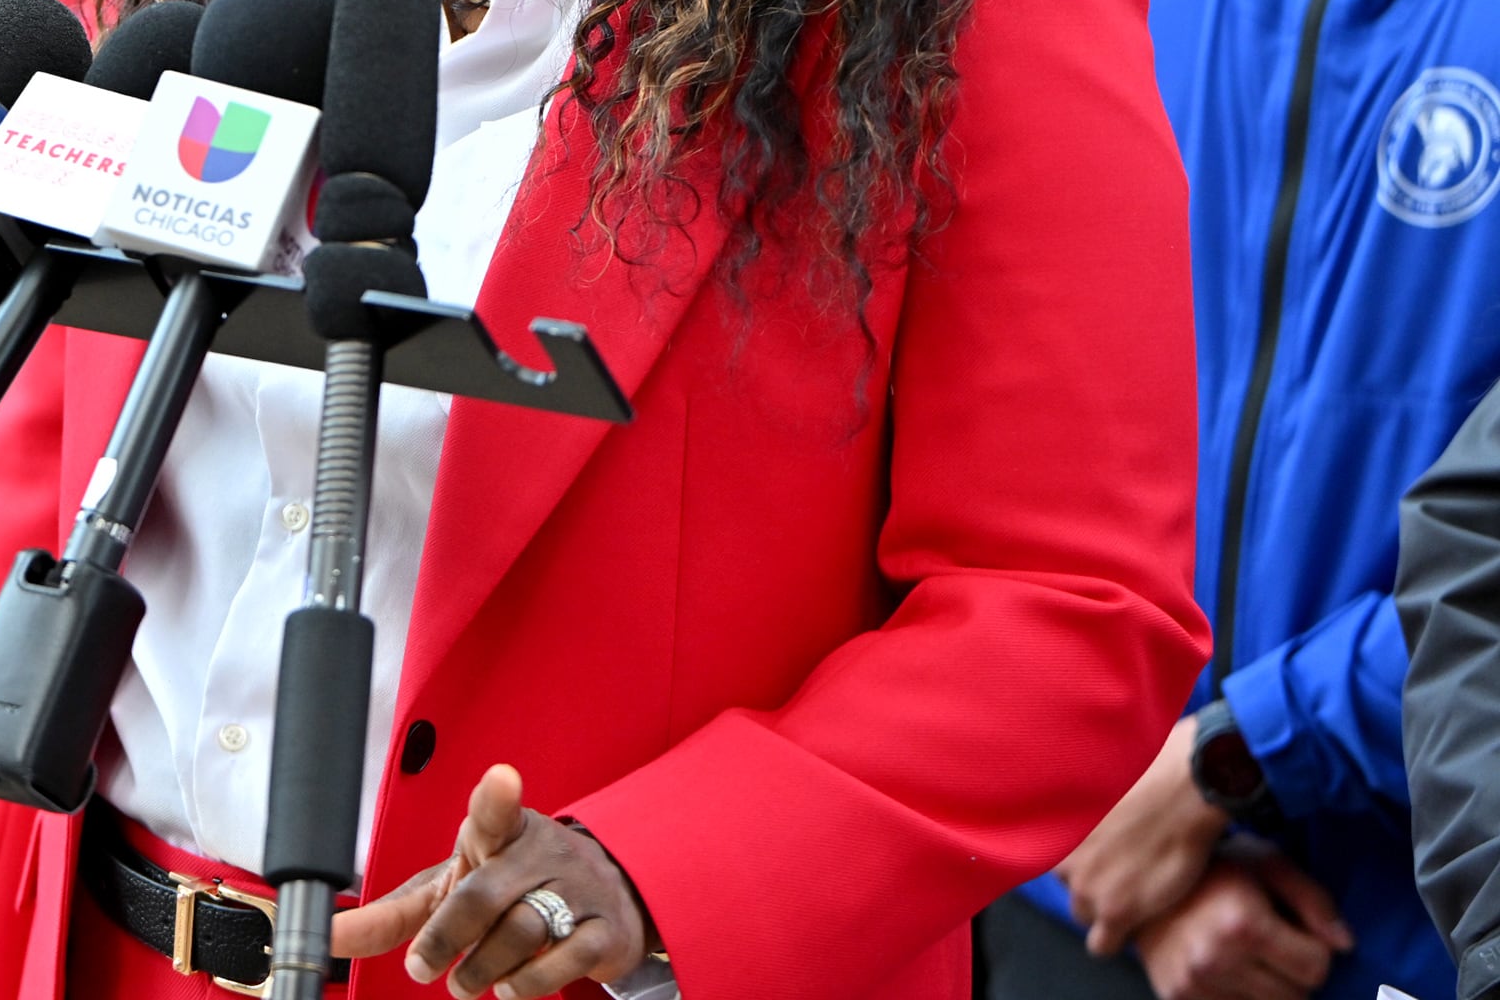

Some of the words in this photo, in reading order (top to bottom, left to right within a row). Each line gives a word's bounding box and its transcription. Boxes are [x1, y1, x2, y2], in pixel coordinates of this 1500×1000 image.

[3, 129, 127, 177] TEACHERS
[132, 183, 252, 230] NOTICIAS
[134, 207, 235, 247] CHICAGO
